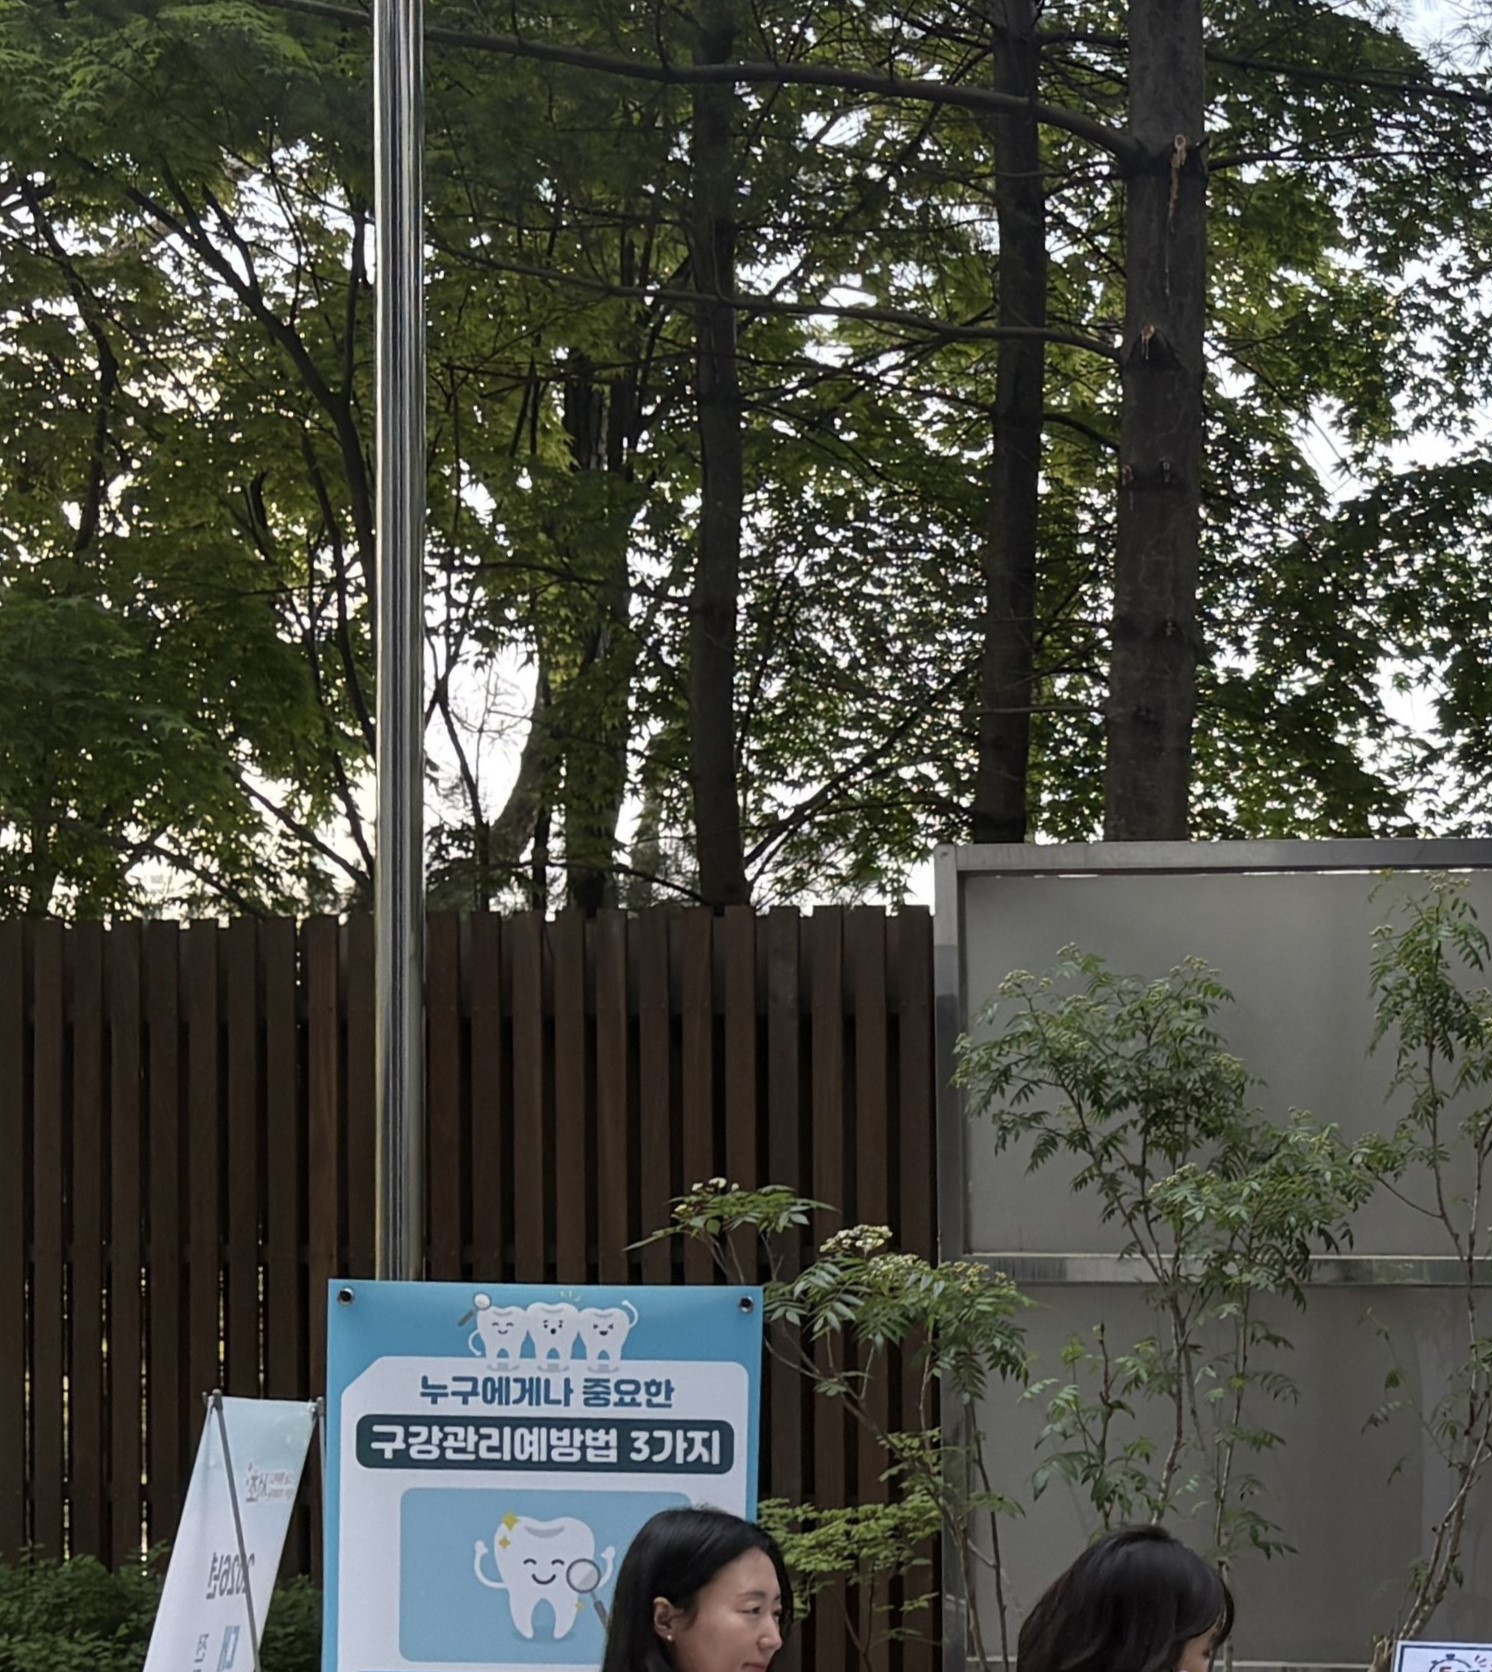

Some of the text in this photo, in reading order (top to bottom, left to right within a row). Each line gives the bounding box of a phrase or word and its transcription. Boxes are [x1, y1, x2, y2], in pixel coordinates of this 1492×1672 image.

[420, 1375, 674, 1408] 누구에게나 중요한
[370, 1424, 721, 1465] 구강관리예방법 3가지
